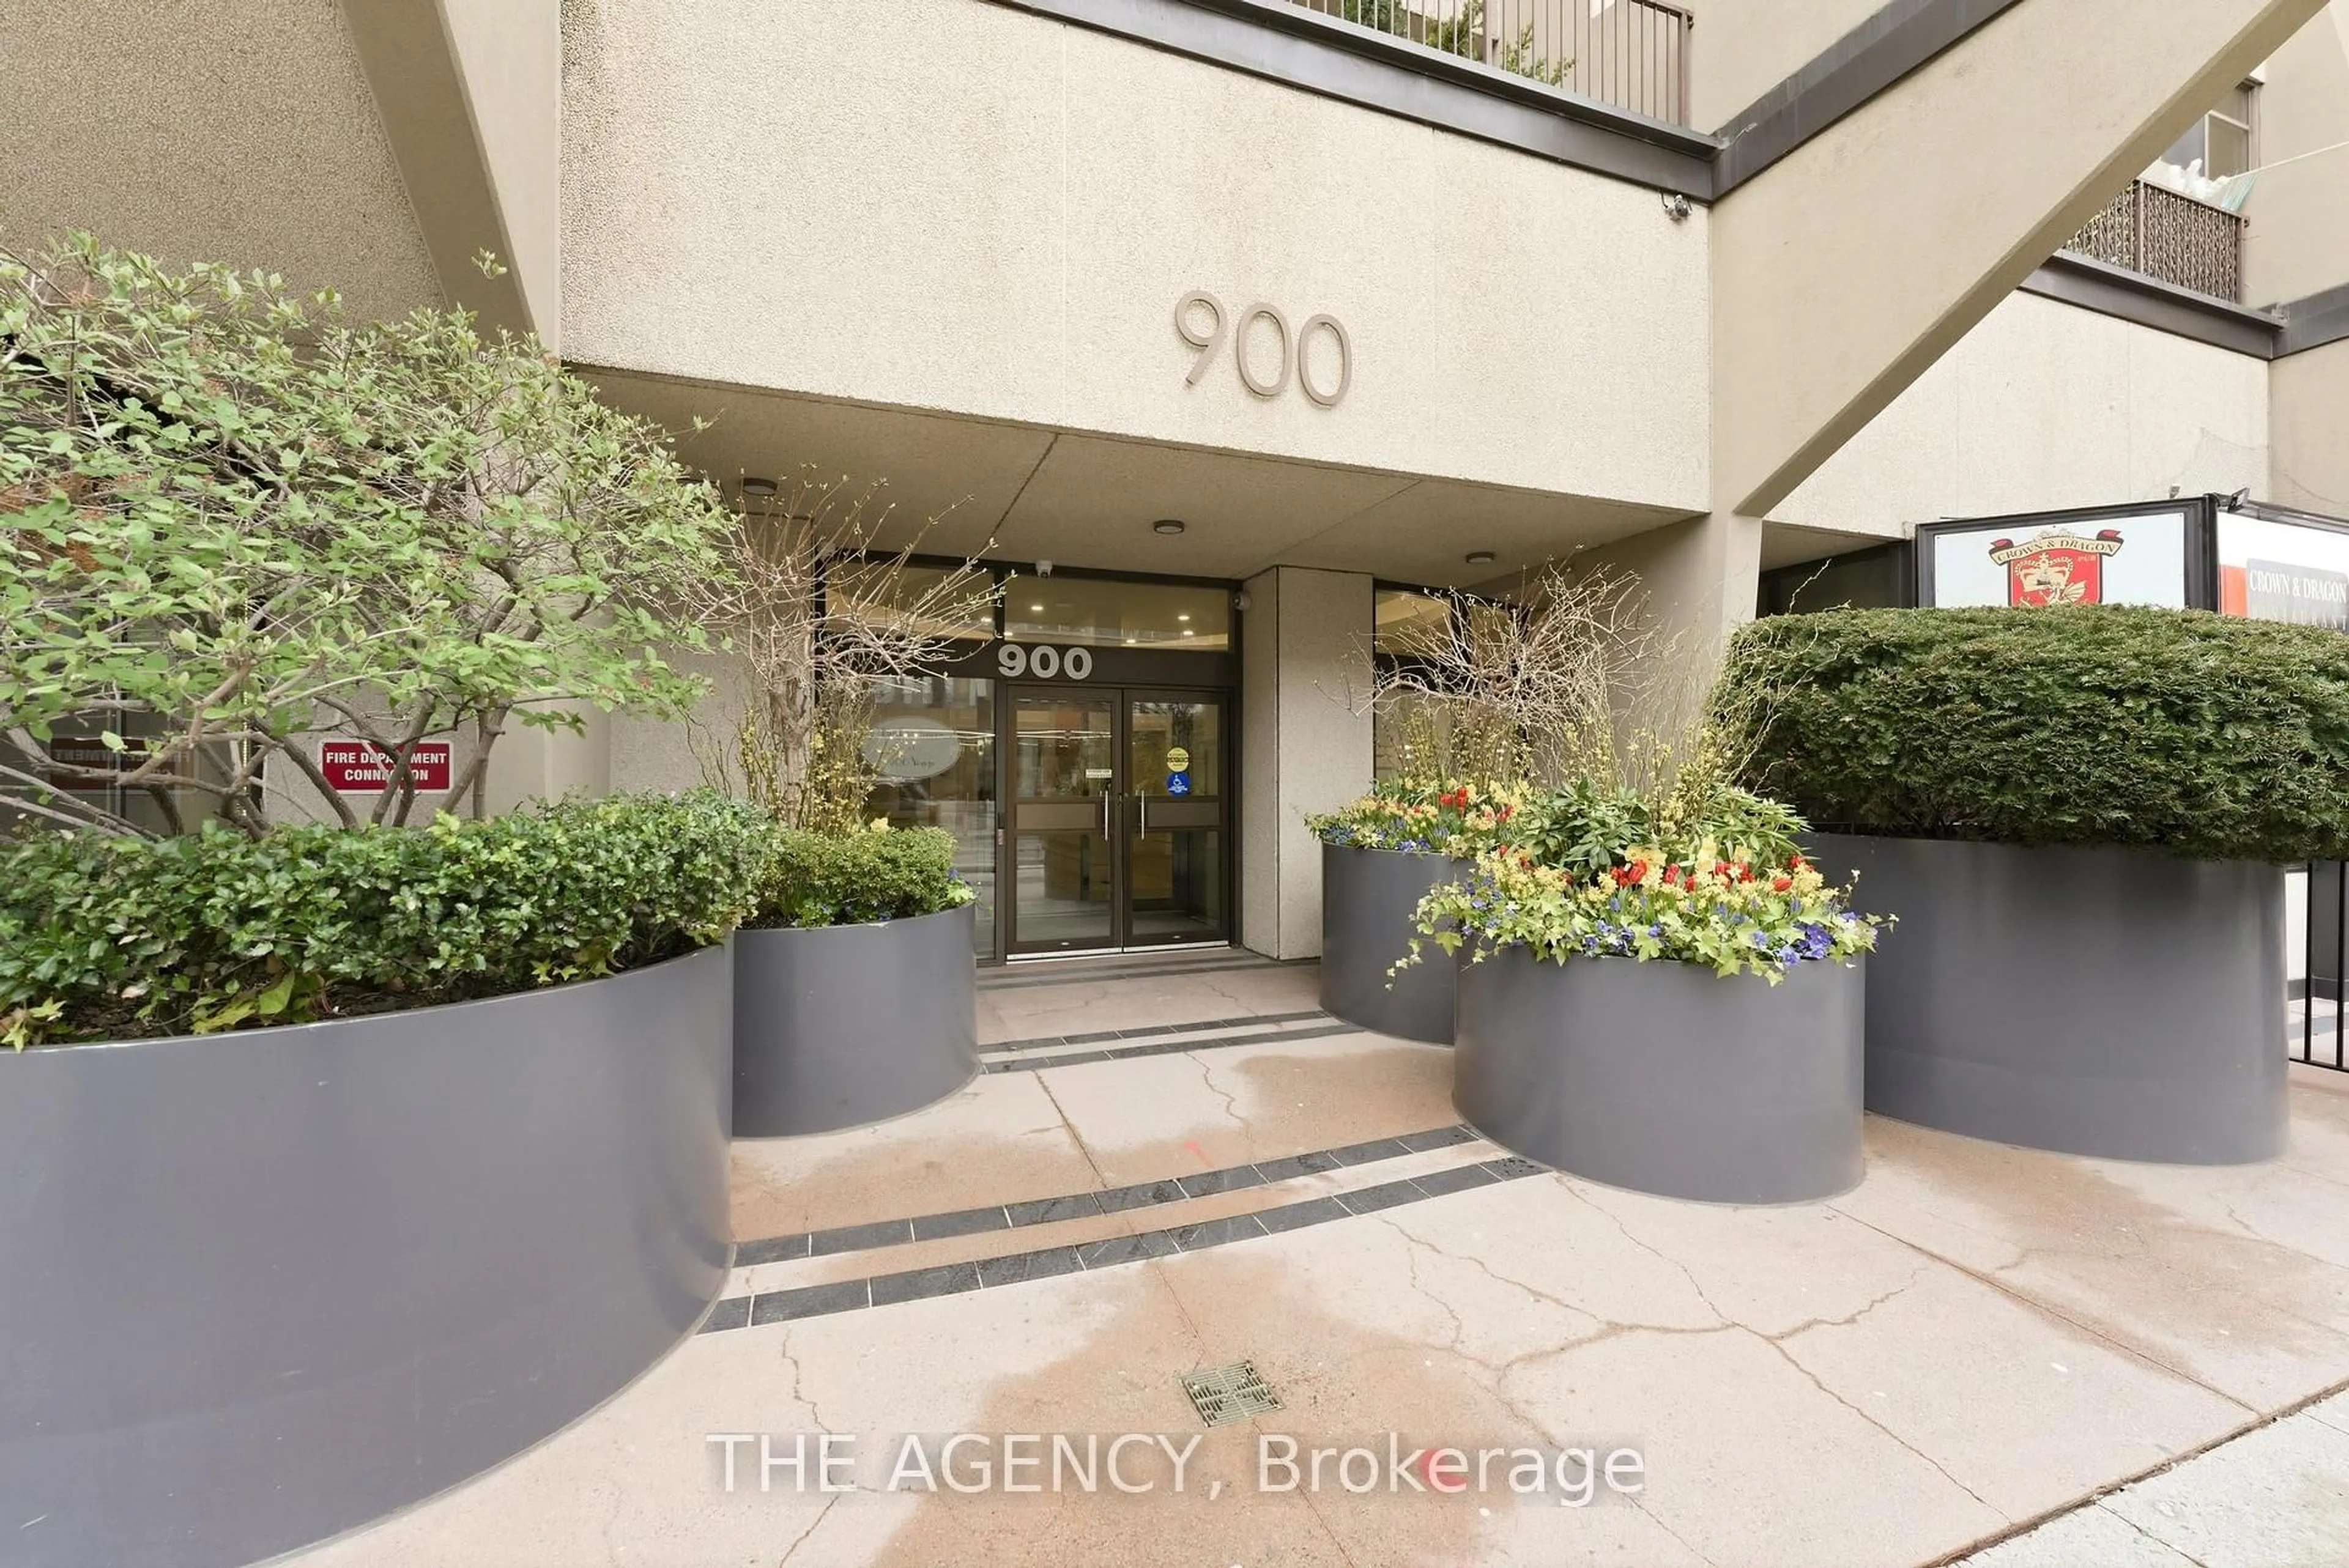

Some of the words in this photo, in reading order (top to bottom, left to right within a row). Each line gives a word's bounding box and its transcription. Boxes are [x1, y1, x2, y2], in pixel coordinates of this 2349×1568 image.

[1174, 289, 1353, 406] 900
[1997, 543, 2043, 562] CROWN
[2047, 539, 2055, 548] &
[2060, 539, 2116, 553] DRAGON
[2249, 569, 2290, 596] CROWN
[2291, 577, 2301, 597] &
[2303, 577, 2347, 604] DRAGON
[998, 643, 1093, 680] 900
[326, 752, 357, 763] FIRE
[360, 752, 447, 764] DPAMENT
[344, 769, 429, 781] CONNON
